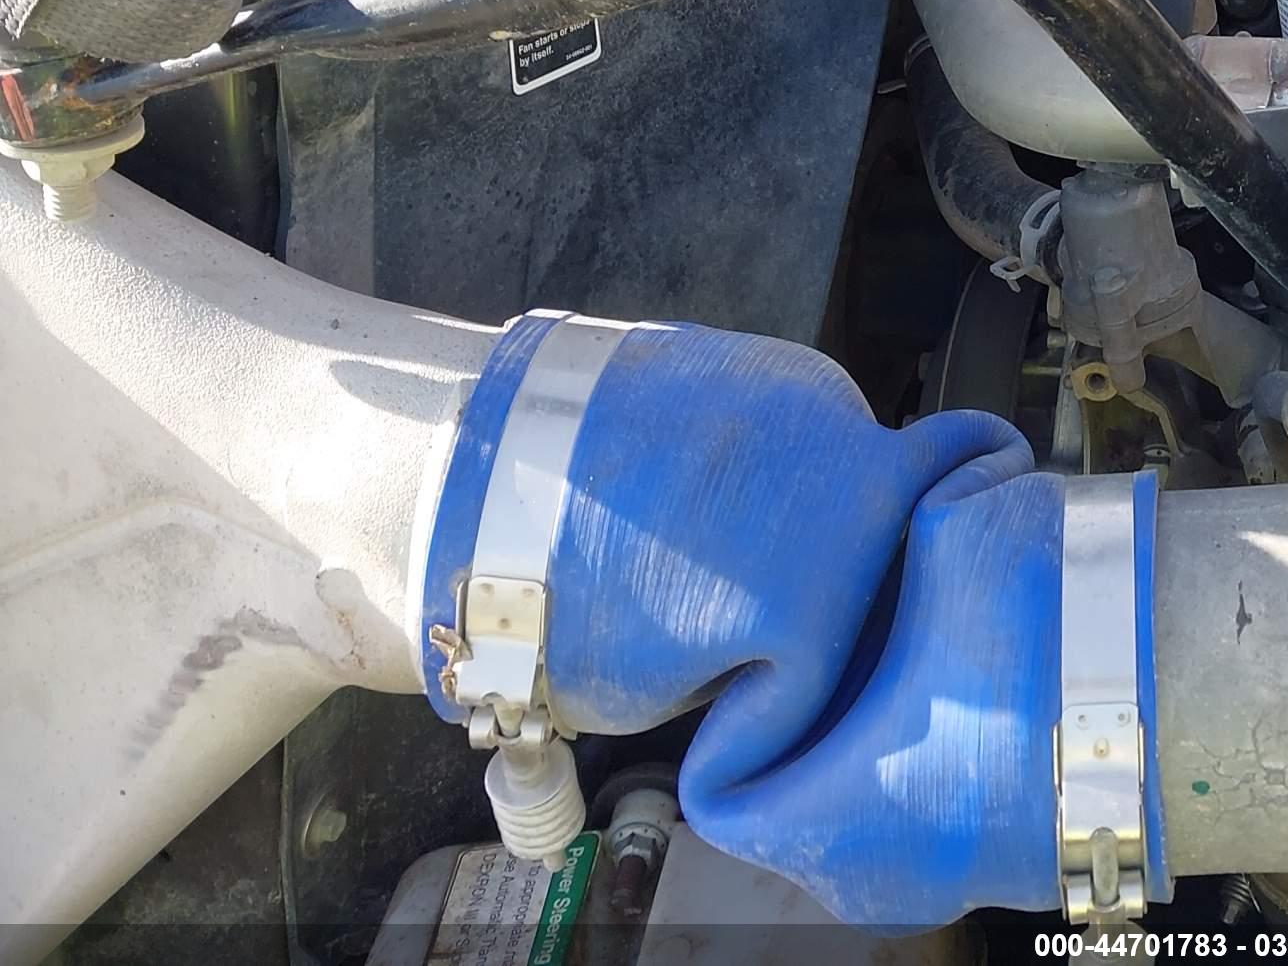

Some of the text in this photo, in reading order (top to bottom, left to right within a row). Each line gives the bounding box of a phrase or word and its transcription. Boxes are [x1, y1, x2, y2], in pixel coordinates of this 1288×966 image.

[518, 43, 534, 55] Fan
[534, 32, 559, 49] starts
[559, 26, 568, 36] or
[519, 57, 530, 68] by
[468, 853, 497, 907] DEXRON
[528, 865, 542, 877] to
[486, 875, 515, 934] Automatic
[507, 880, 536, 947] appropriate
[534, 846, 585, 964] Power Steering
